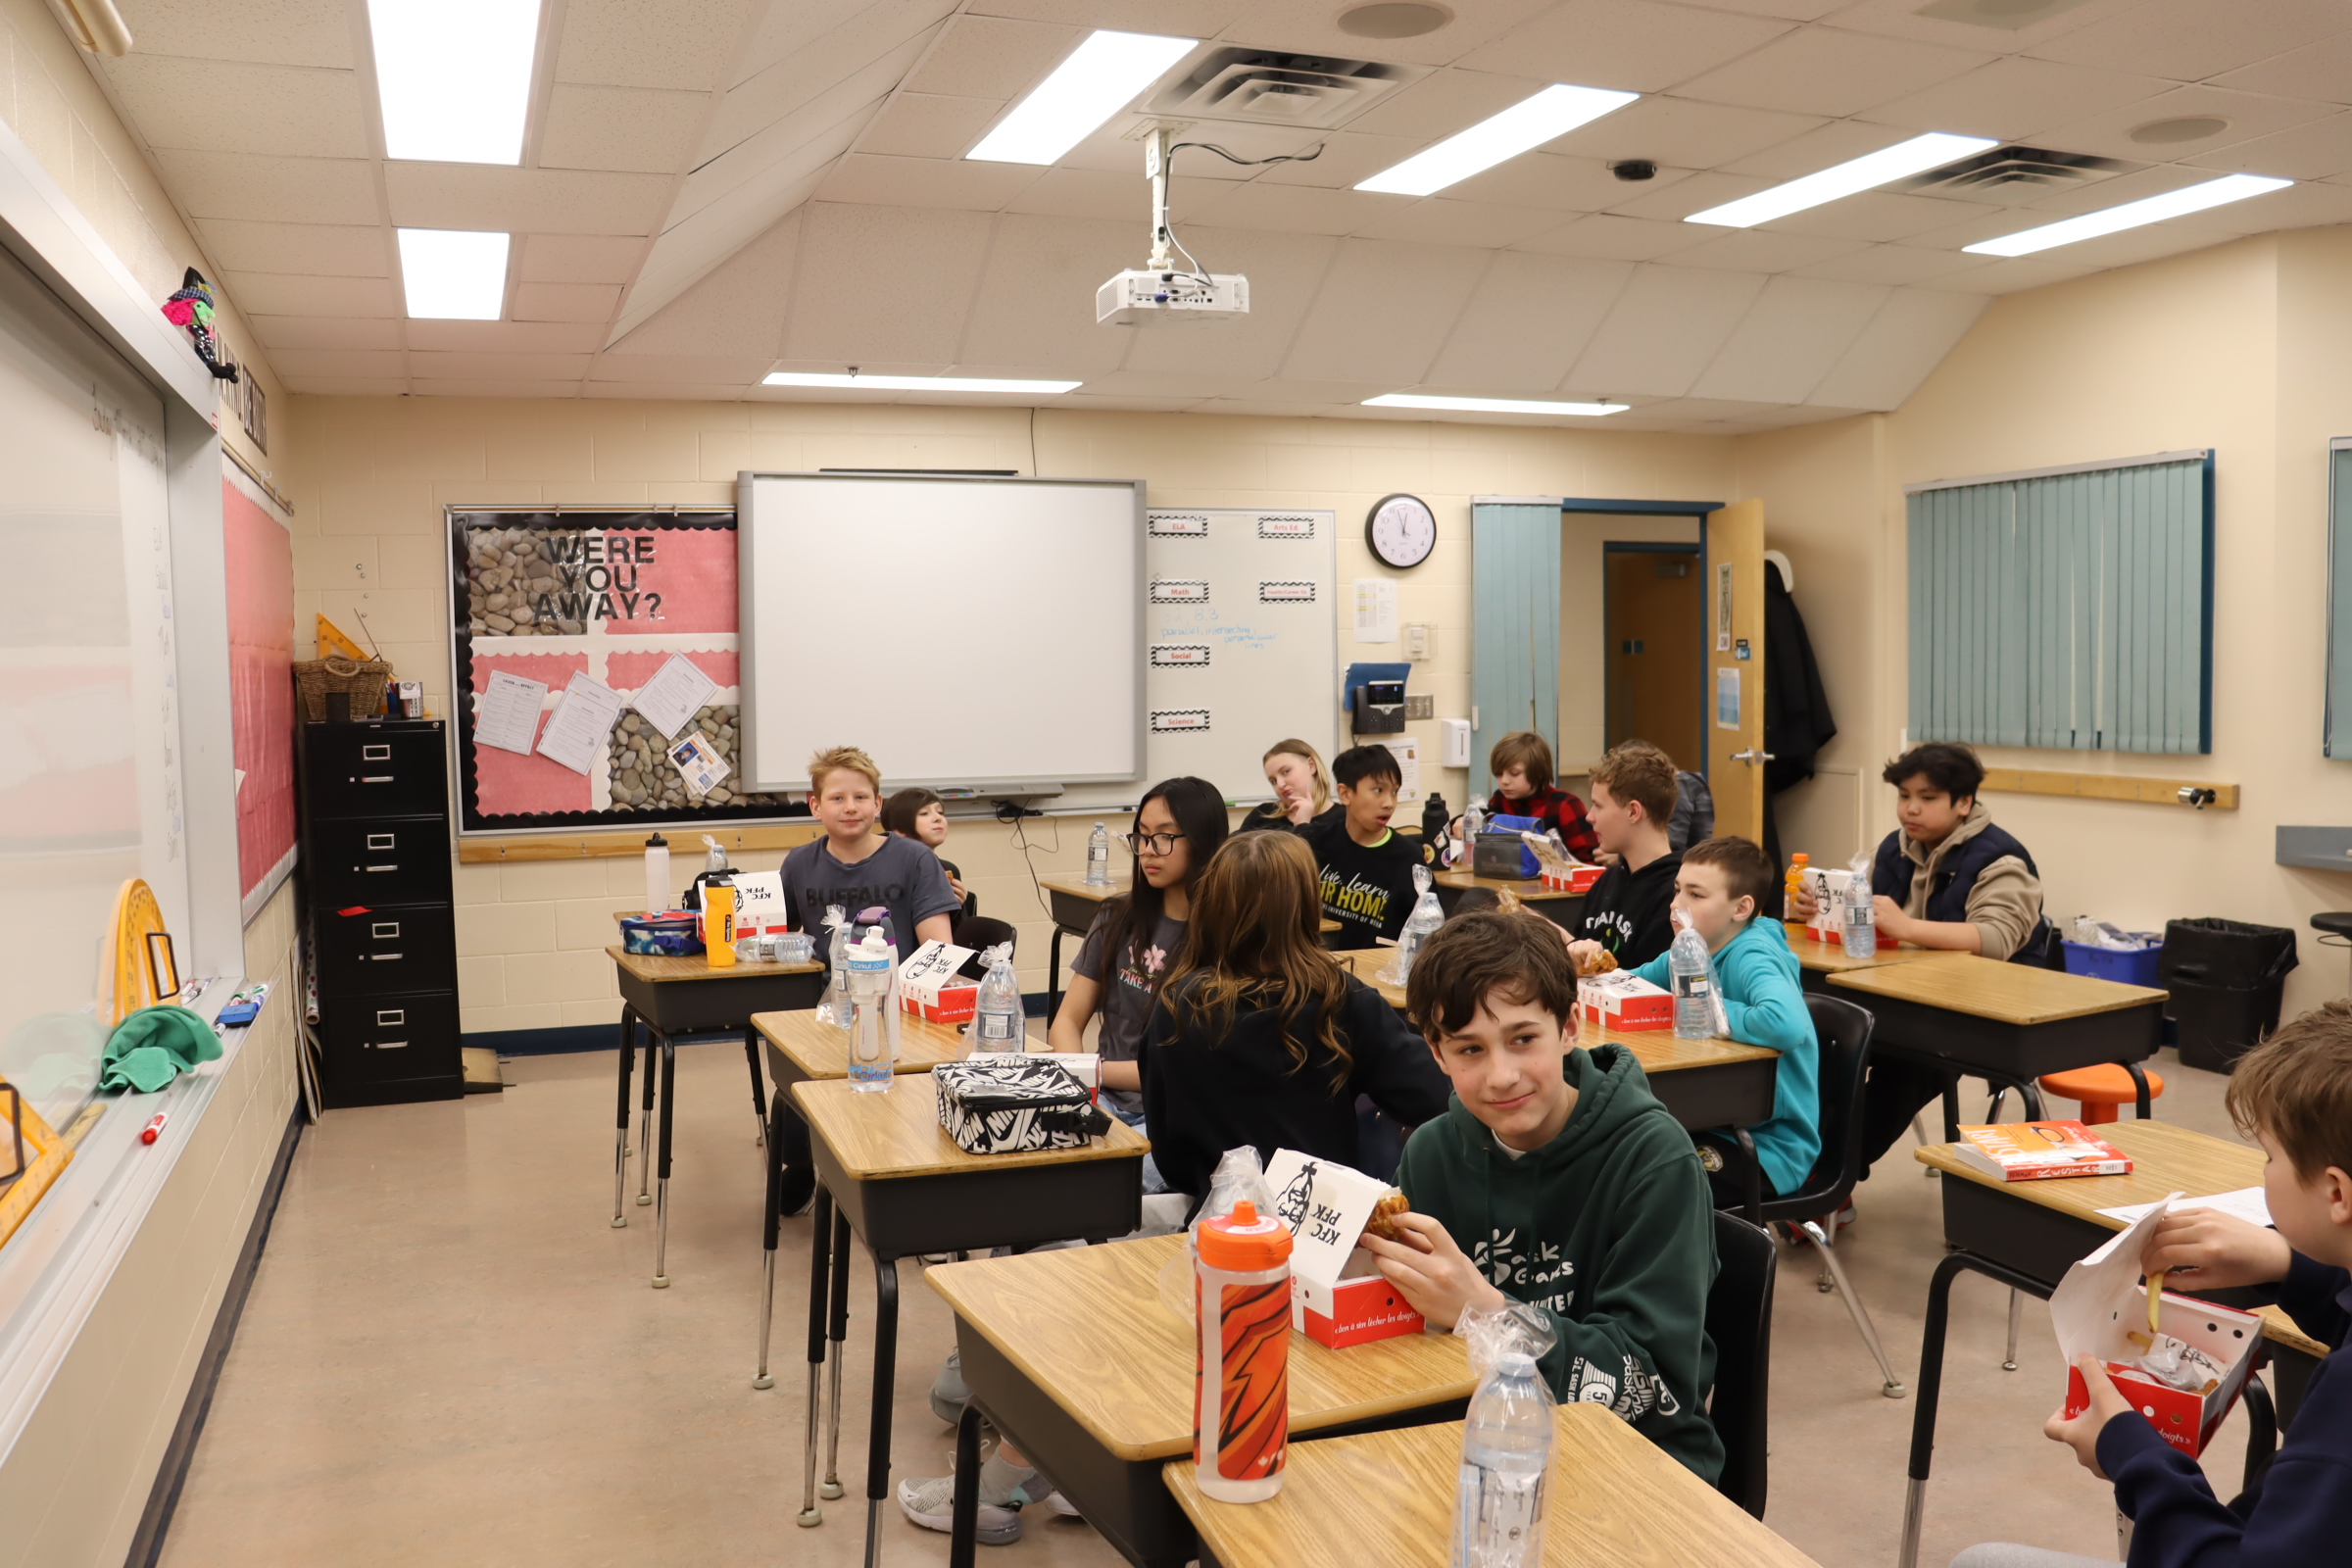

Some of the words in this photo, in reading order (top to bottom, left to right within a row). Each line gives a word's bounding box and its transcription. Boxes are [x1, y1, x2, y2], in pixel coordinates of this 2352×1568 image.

[545, 536, 655, 564] WERE
[559, 565, 637, 592] YOU
[533, 592, 662, 621] AWAY?
[806, 883, 905, 906] BUFFALO
[1119, 968, 1145, 990] TAKE
[1144, 981, 1153, 994] A
[2036, 1163, 2100, 1178] RESTAR
[1312, 1203, 1343, 1227] PFK
[1310, 1223, 1342, 1246] KFC
[1387, 1312, 1396, 1323] les
